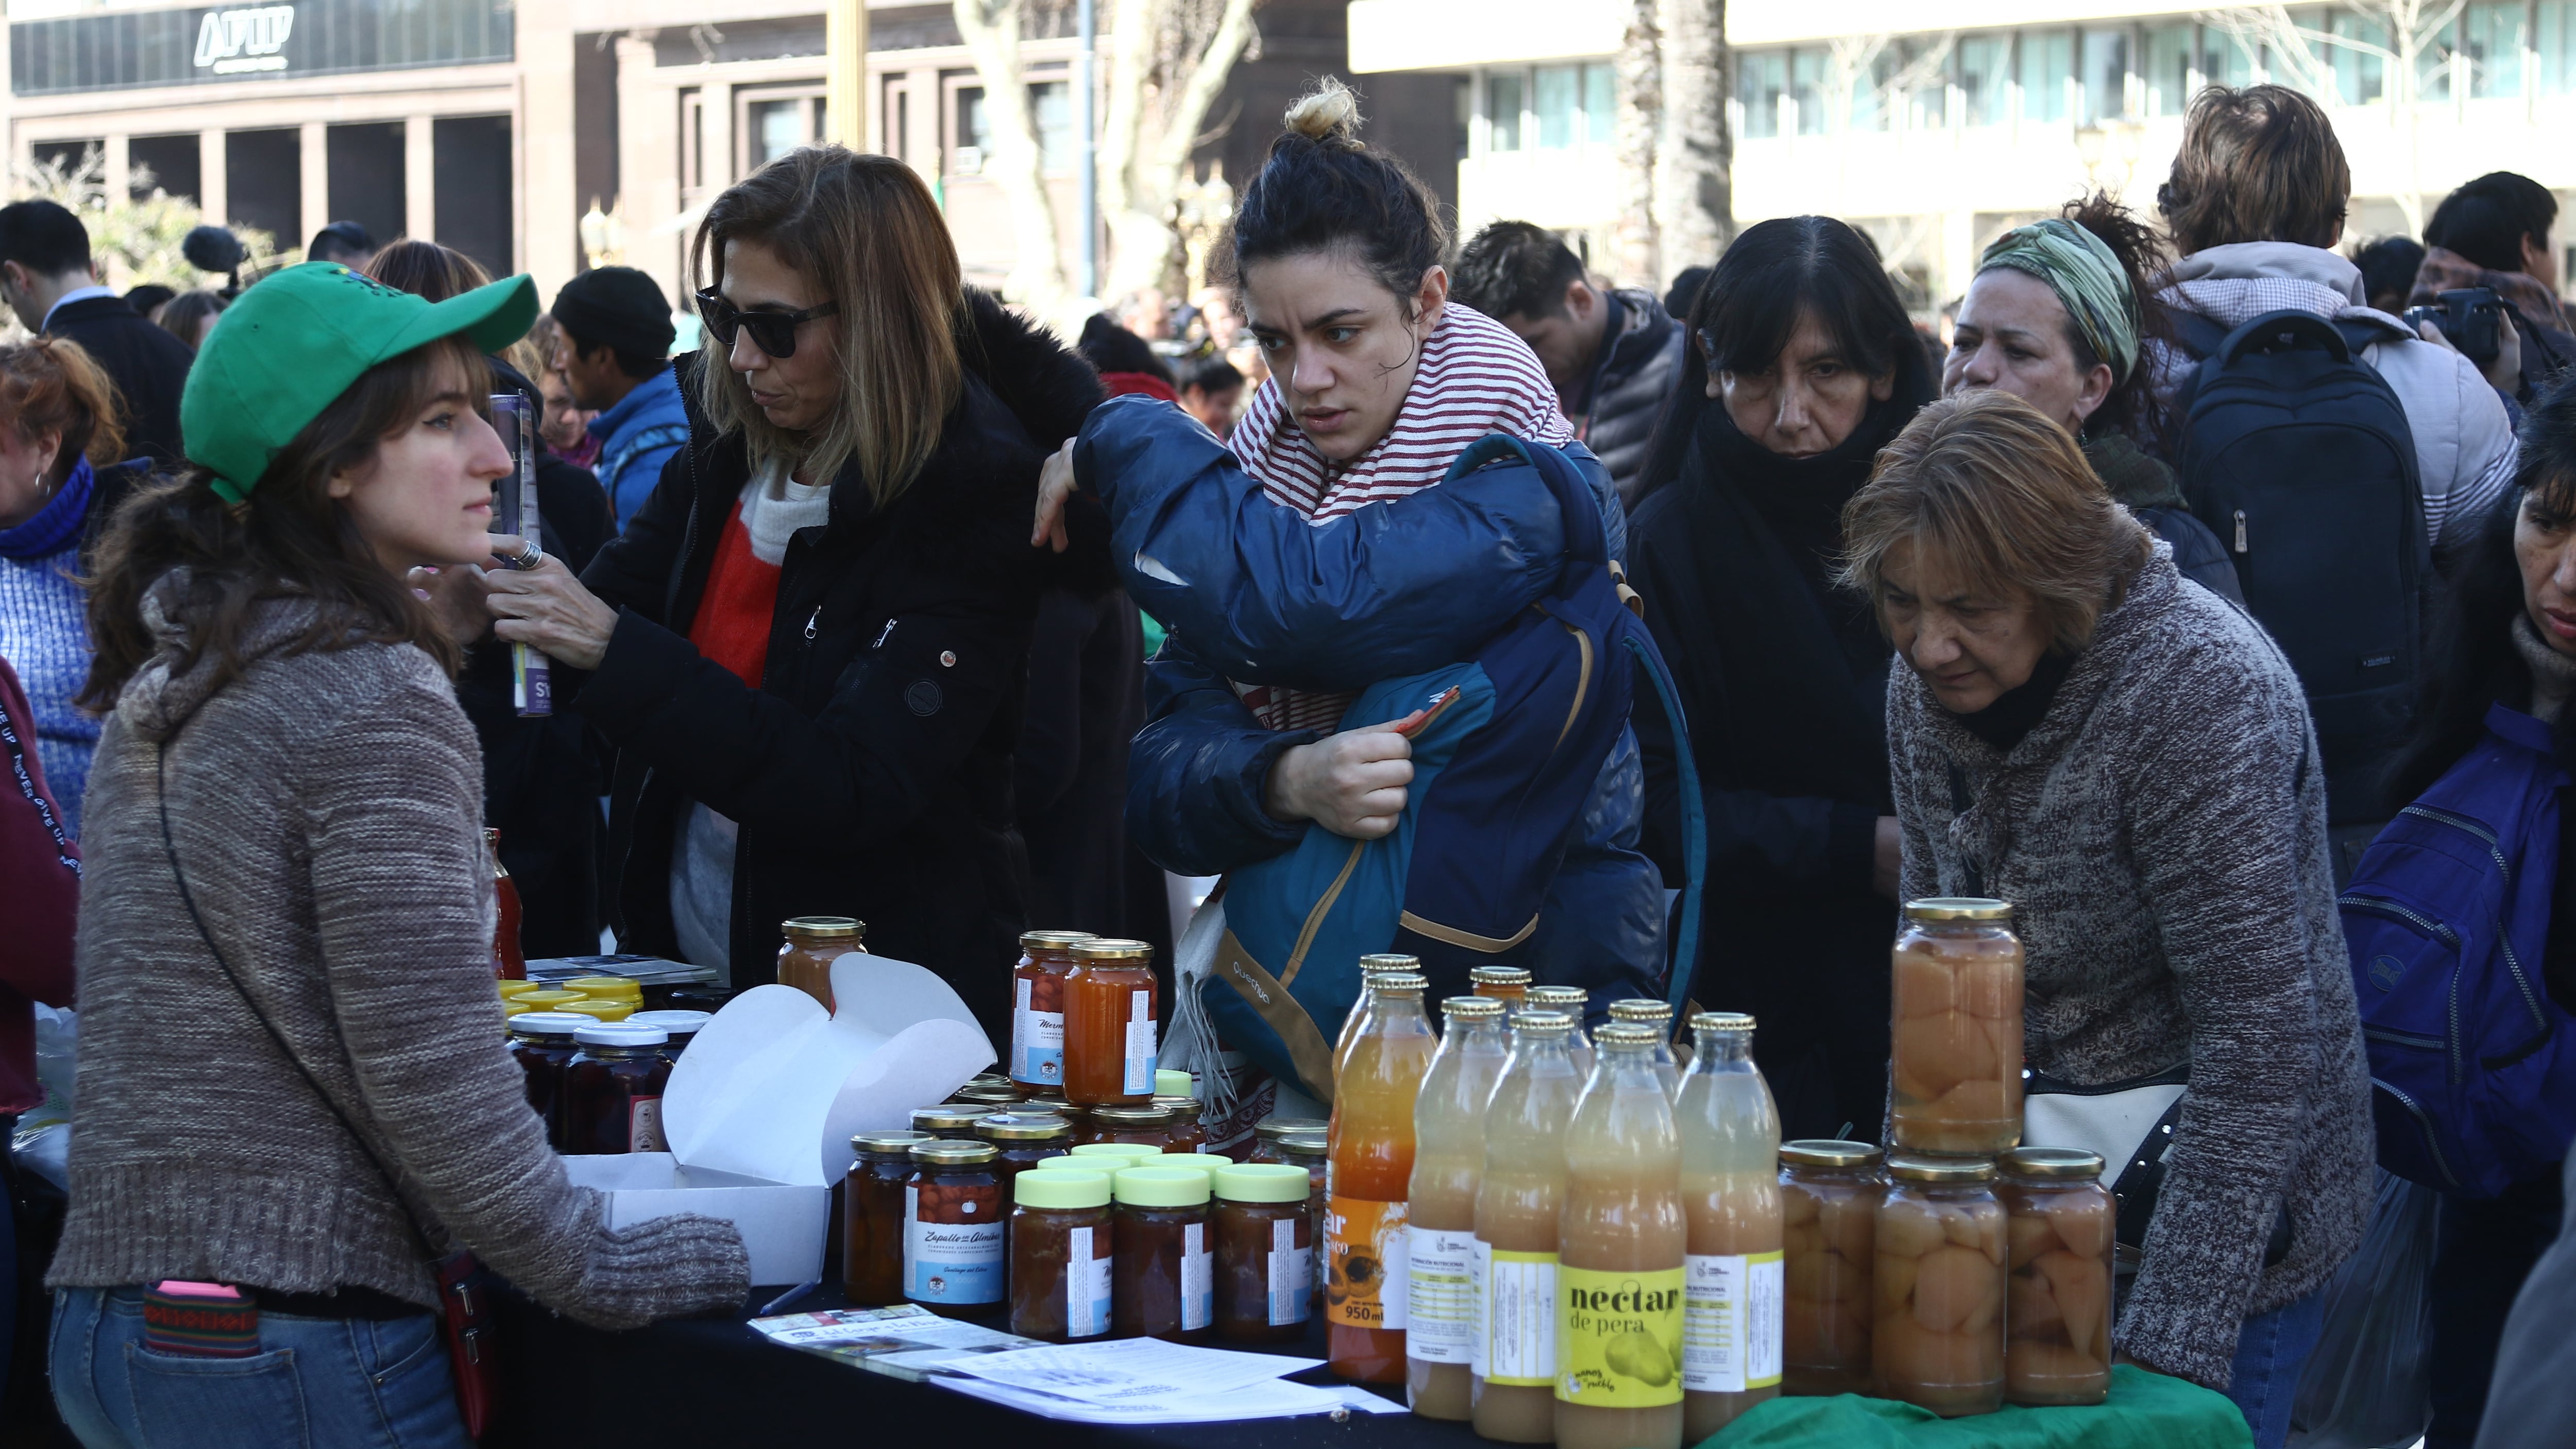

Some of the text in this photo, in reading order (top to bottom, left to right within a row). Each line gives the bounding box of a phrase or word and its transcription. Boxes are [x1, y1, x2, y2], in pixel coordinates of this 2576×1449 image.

[2, 727, 16, 742] UP
[14, 754, 33, 798] NEVER
[34, 798, 55, 827] GIVE
[54, 827, 65, 845] UP
[1233, 961, 1270, 1004] Quechua
[925, 1231, 960, 1243] Zapallo
[1571, 1280, 1680, 1313] néctar
[1346, 1306, 1383, 1321] 950 ml
[1571, 1311, 1645, 1337] de pera
